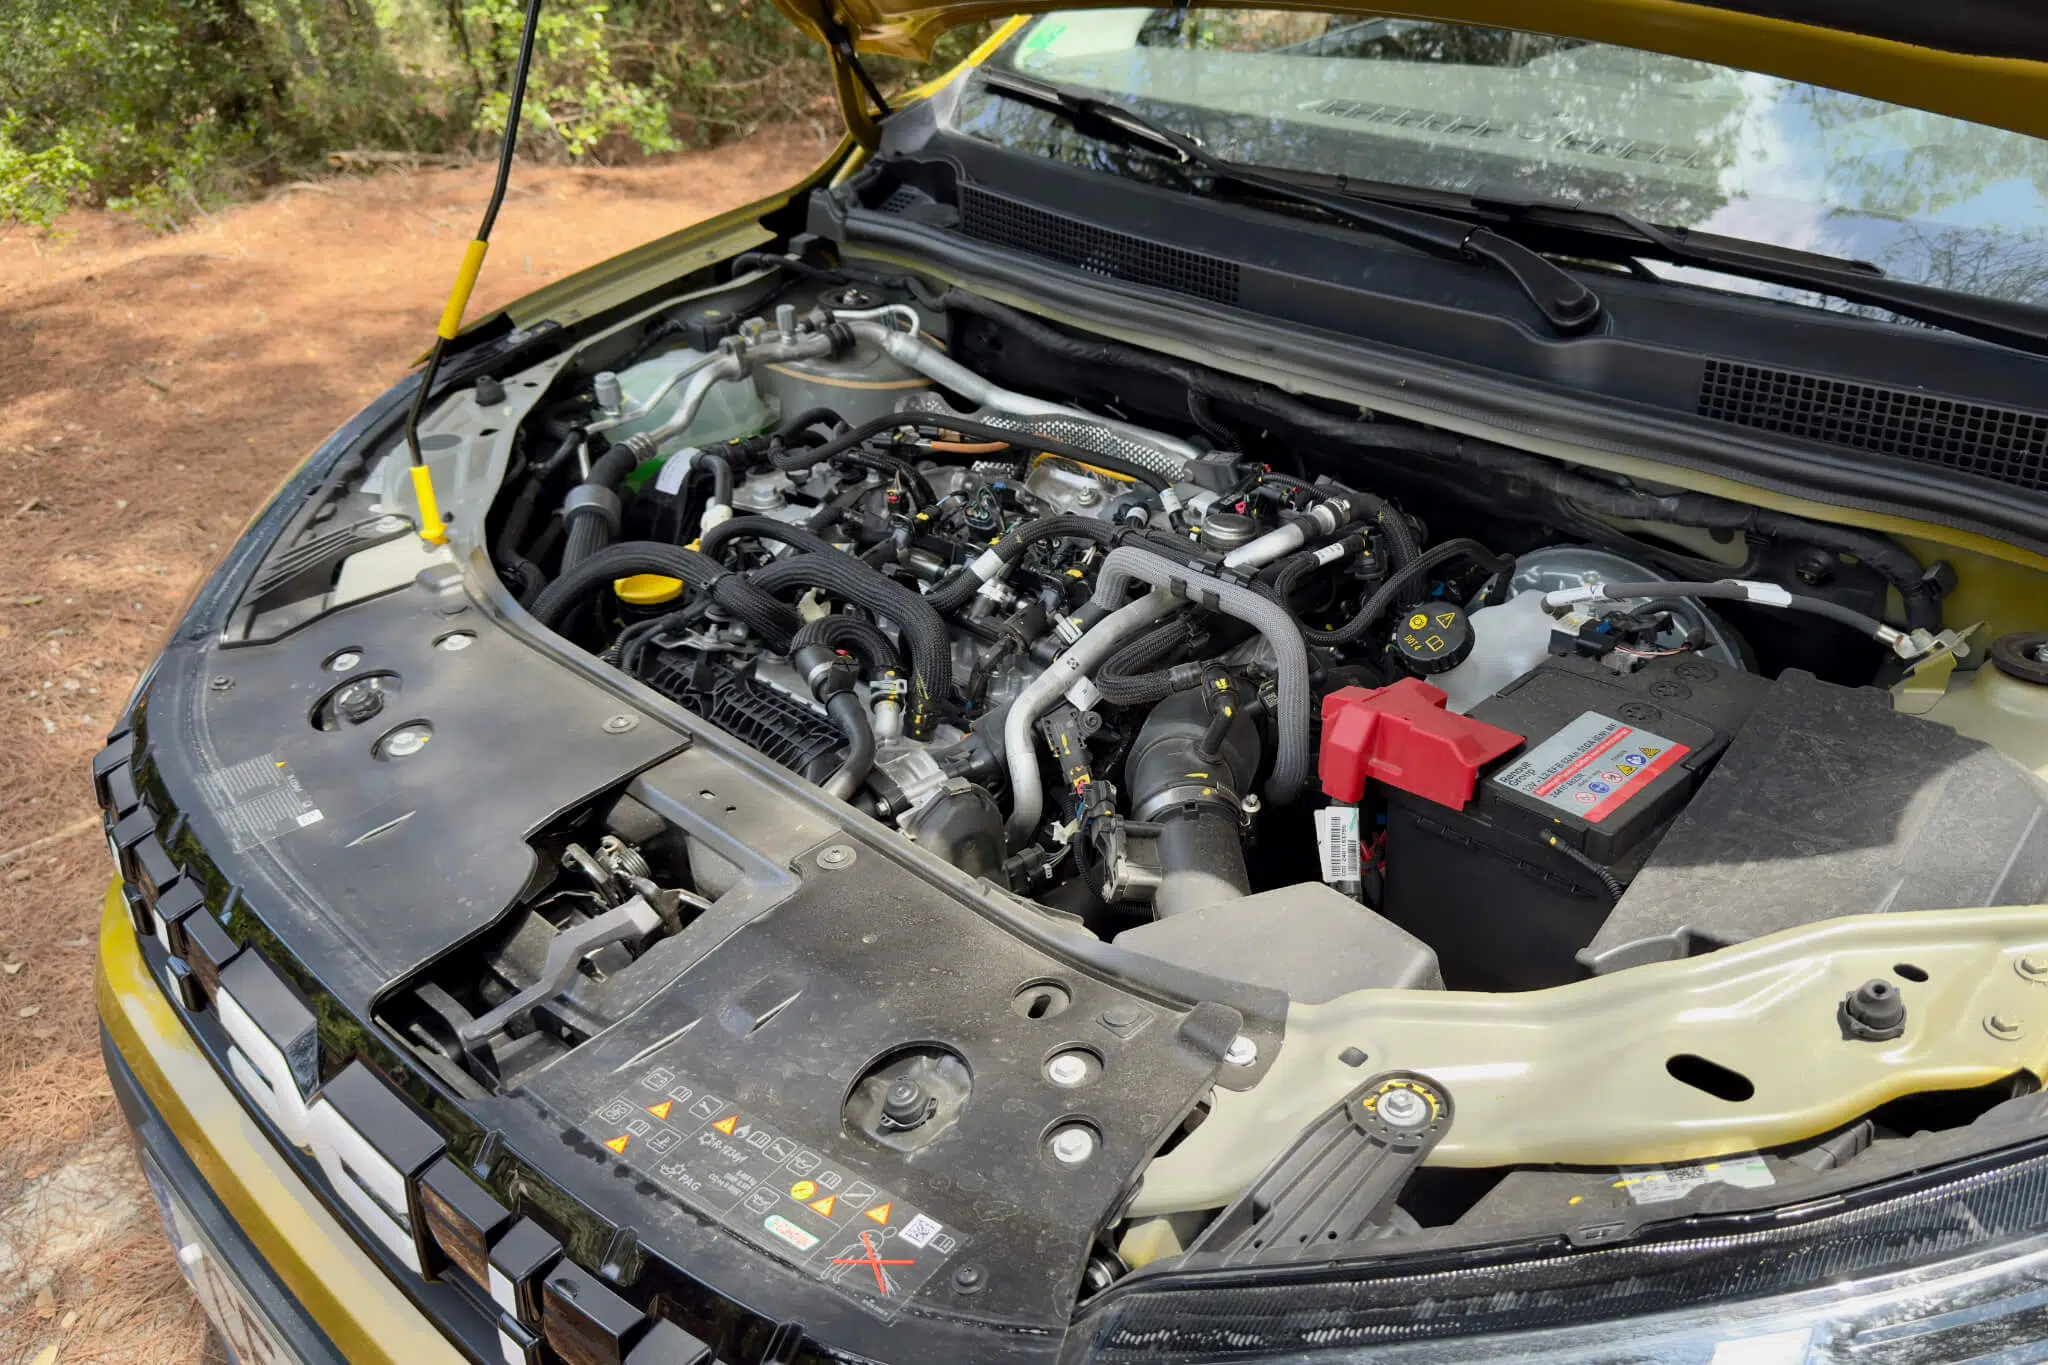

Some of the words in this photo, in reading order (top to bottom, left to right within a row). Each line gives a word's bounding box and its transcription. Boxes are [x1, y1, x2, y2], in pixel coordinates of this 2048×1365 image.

[1501, 761, 1532, 783] Renault
[1508, 768, 1536, 787] Group
[679, 1174, 702, 1191] PAG
